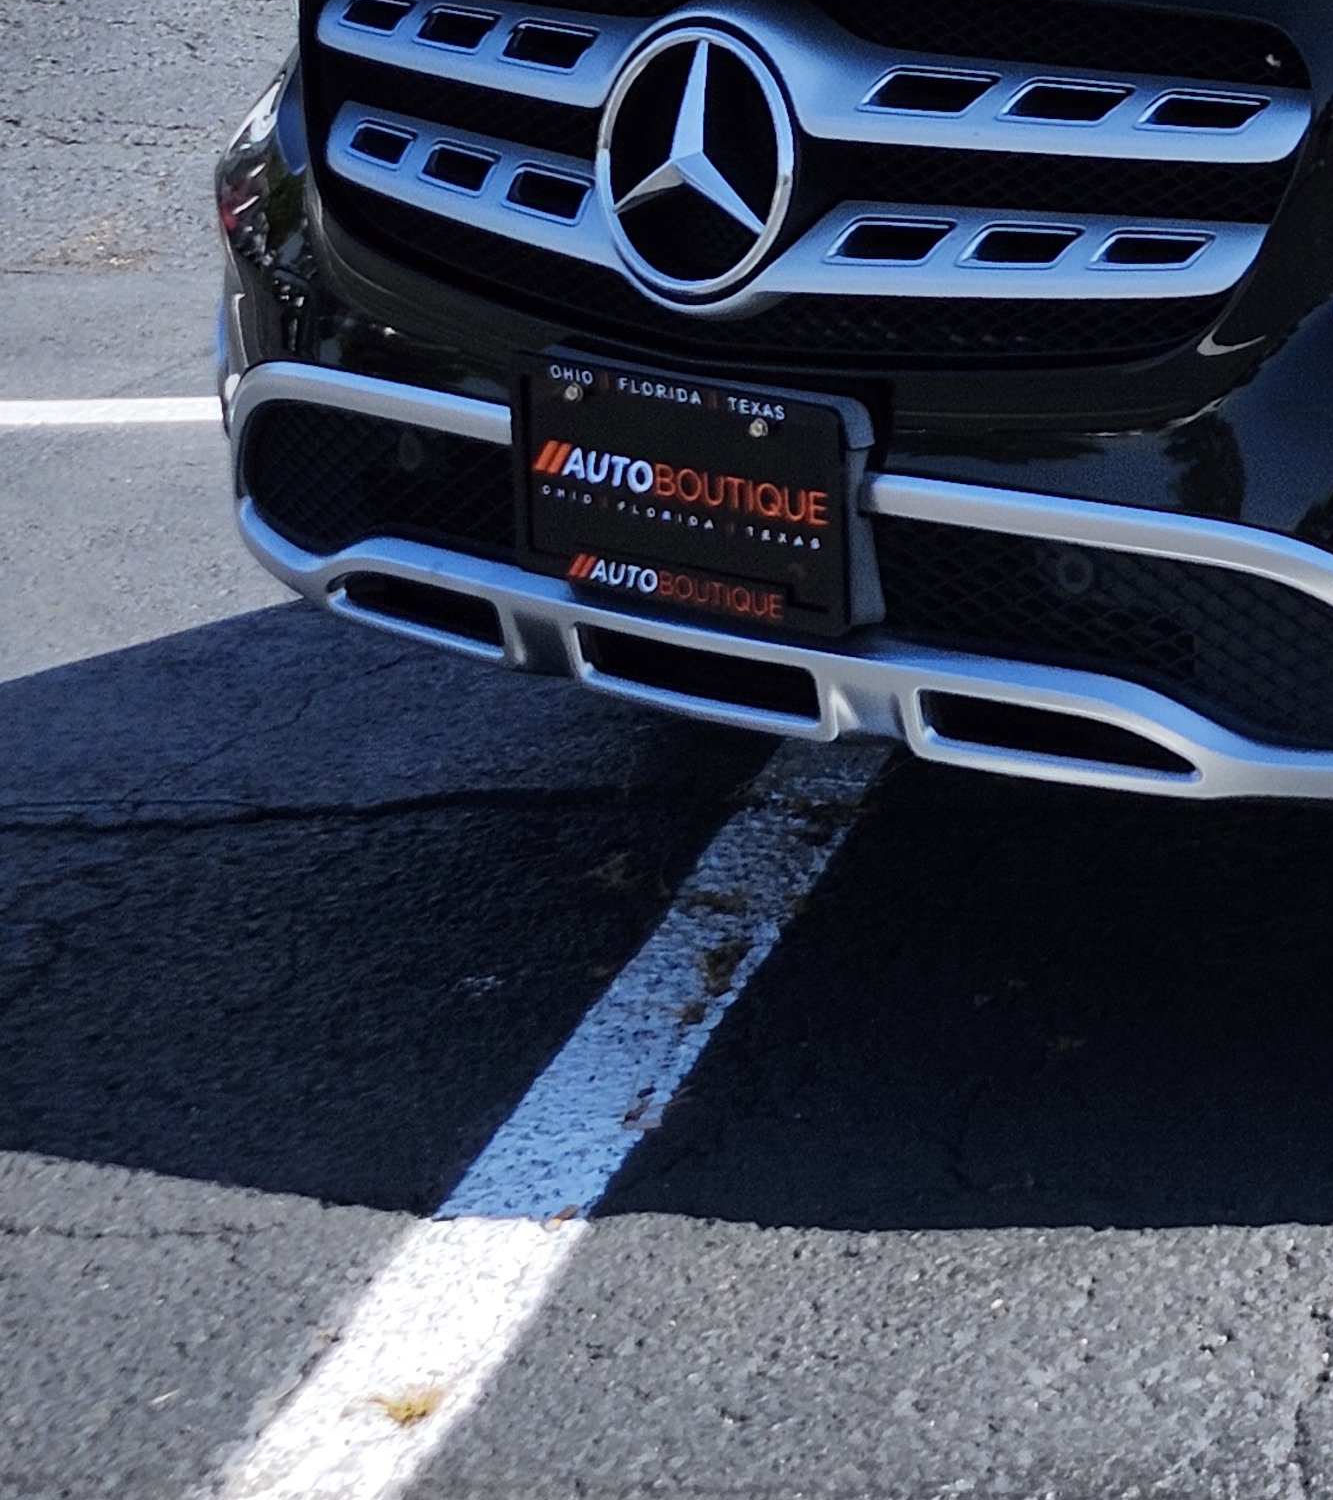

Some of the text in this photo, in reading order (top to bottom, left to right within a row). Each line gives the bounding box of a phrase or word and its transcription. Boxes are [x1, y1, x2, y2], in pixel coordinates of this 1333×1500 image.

[550, 364, 786, 421] OHIO FLORIDA TEXAS
[541, 484, 821, 550] OHIO FLORIDA TEXAS
